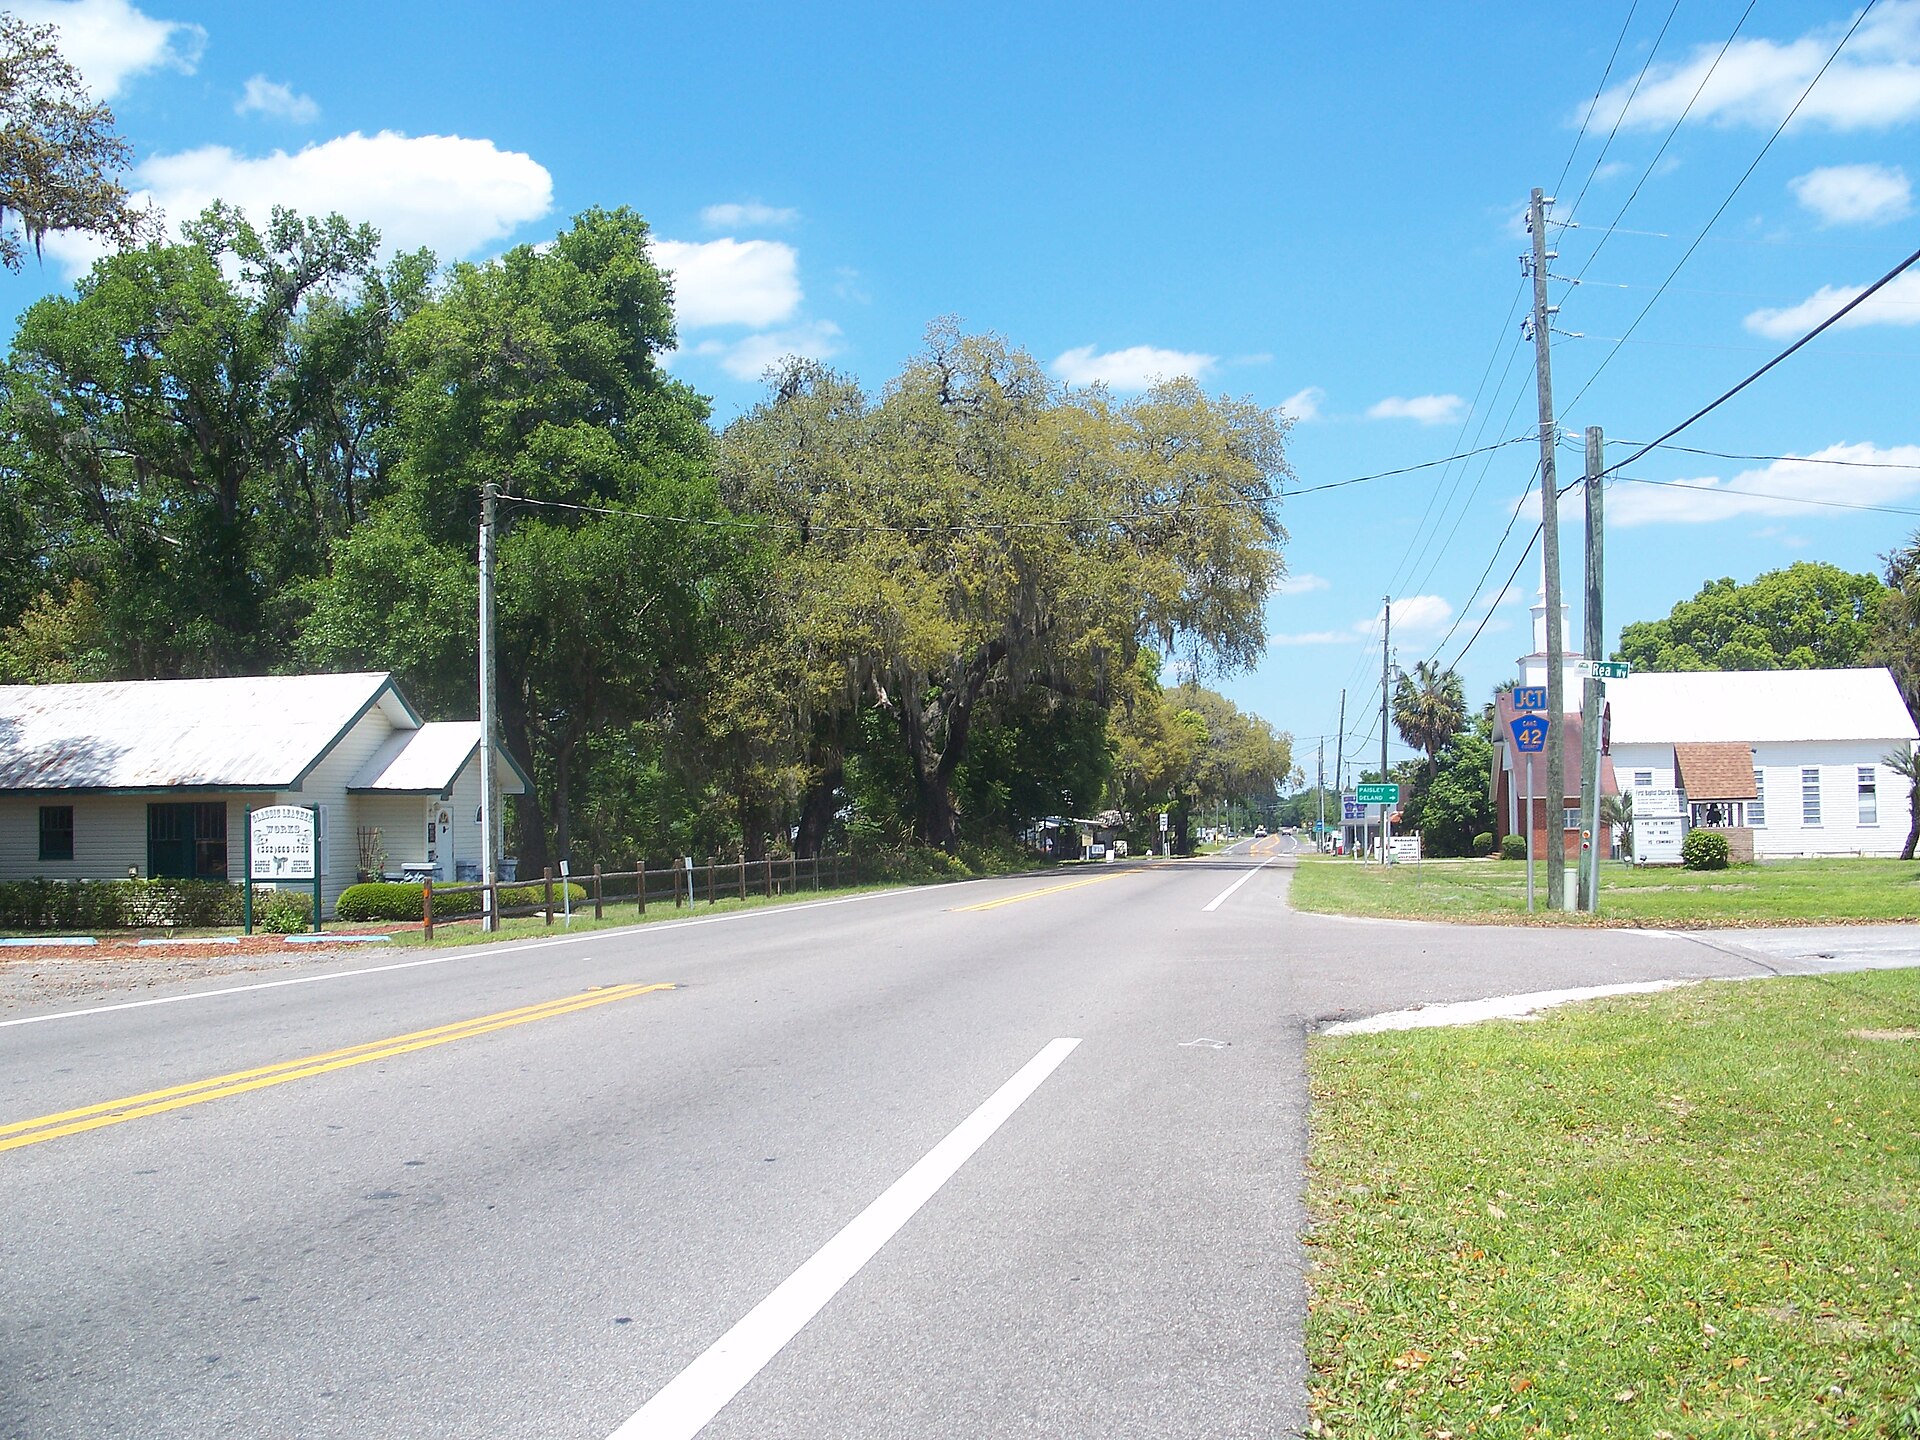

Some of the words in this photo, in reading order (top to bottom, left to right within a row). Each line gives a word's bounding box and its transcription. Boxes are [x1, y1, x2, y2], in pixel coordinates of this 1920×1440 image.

[1592, 663, 1610, 676] Rea
[1516, 689, 1543, 707] JCT
[1519, 729, 1542, 744] 42
[282, 809, 314, 824] LEATHER
[266, 825, 300, 834] WORKS
